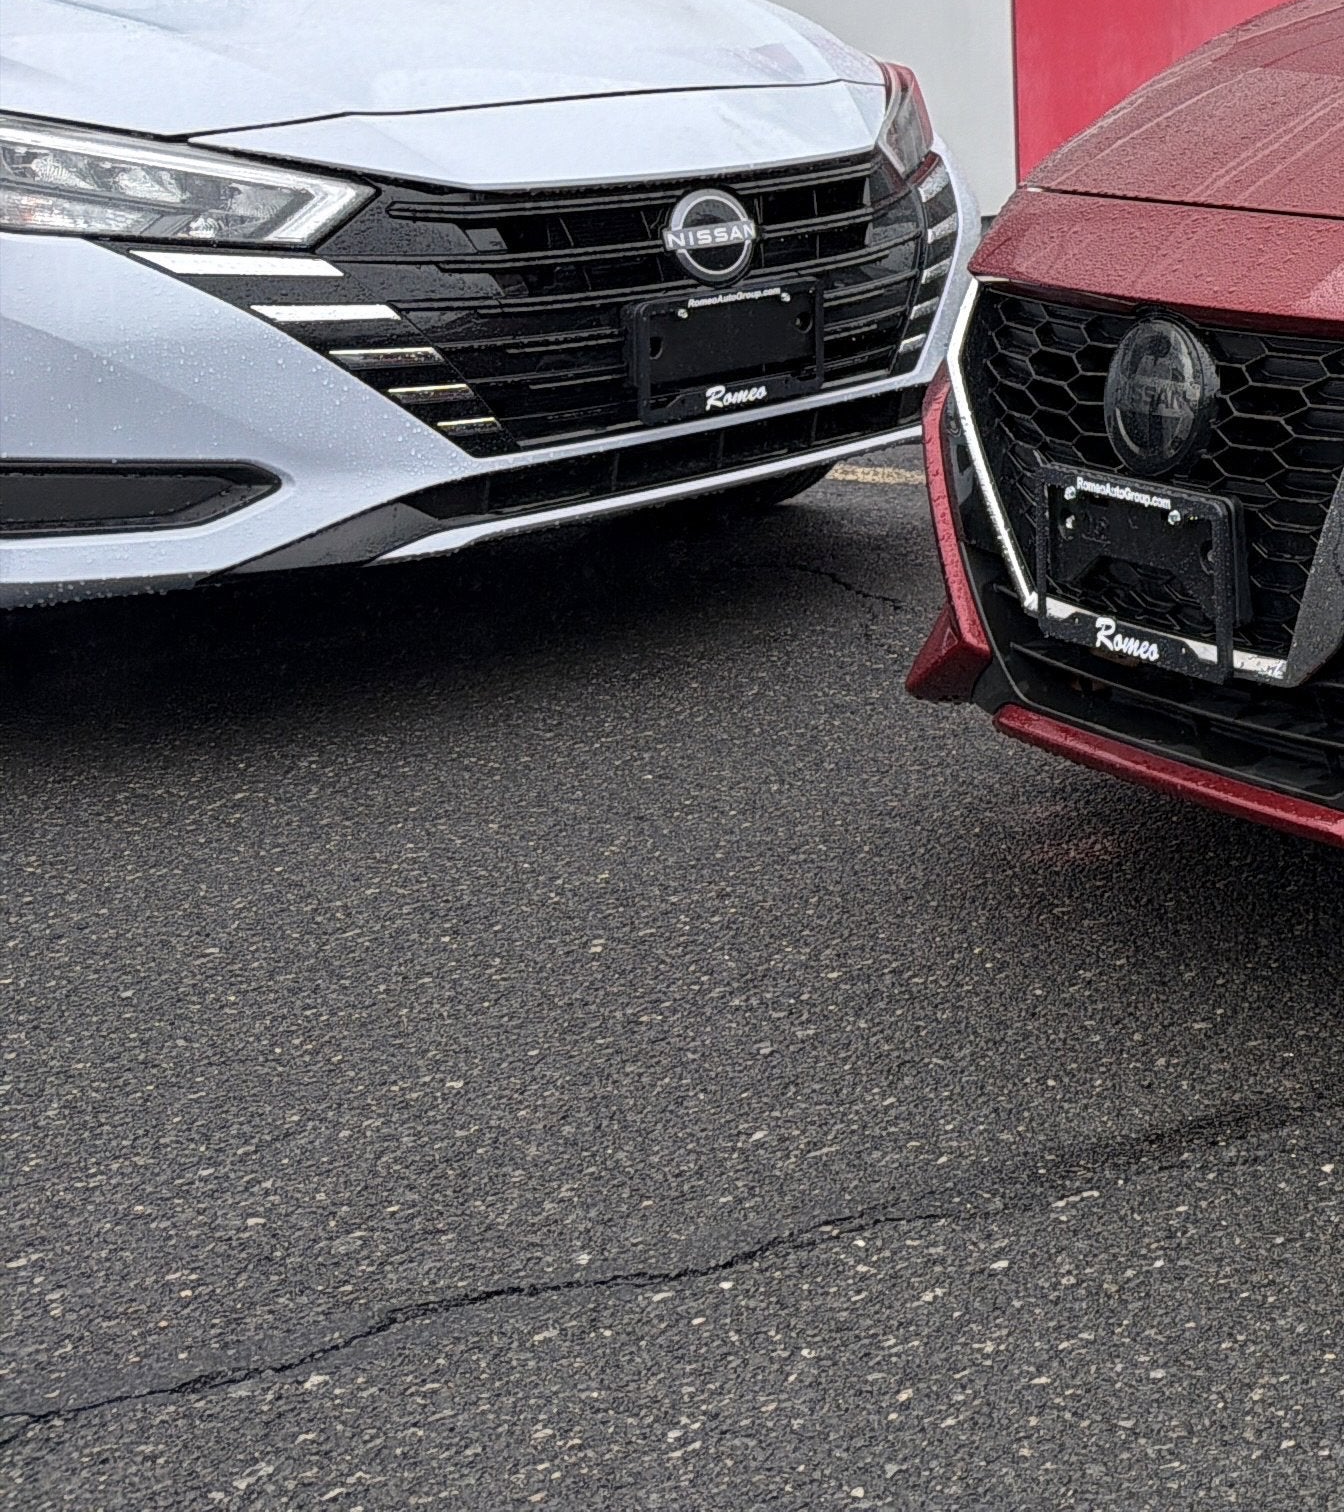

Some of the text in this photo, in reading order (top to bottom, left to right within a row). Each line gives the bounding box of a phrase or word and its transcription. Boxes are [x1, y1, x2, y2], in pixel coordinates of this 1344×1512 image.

[665, 220, 756, 250] NISSAN
[687, 287, 781, 308] RomeoAutoGroup.com
[705, 385, 767, 411] Romeo
[1076, 476, 1172, 510] RomeoAutoGroup.com
[1095, 617, 1160, 662] Romeo
